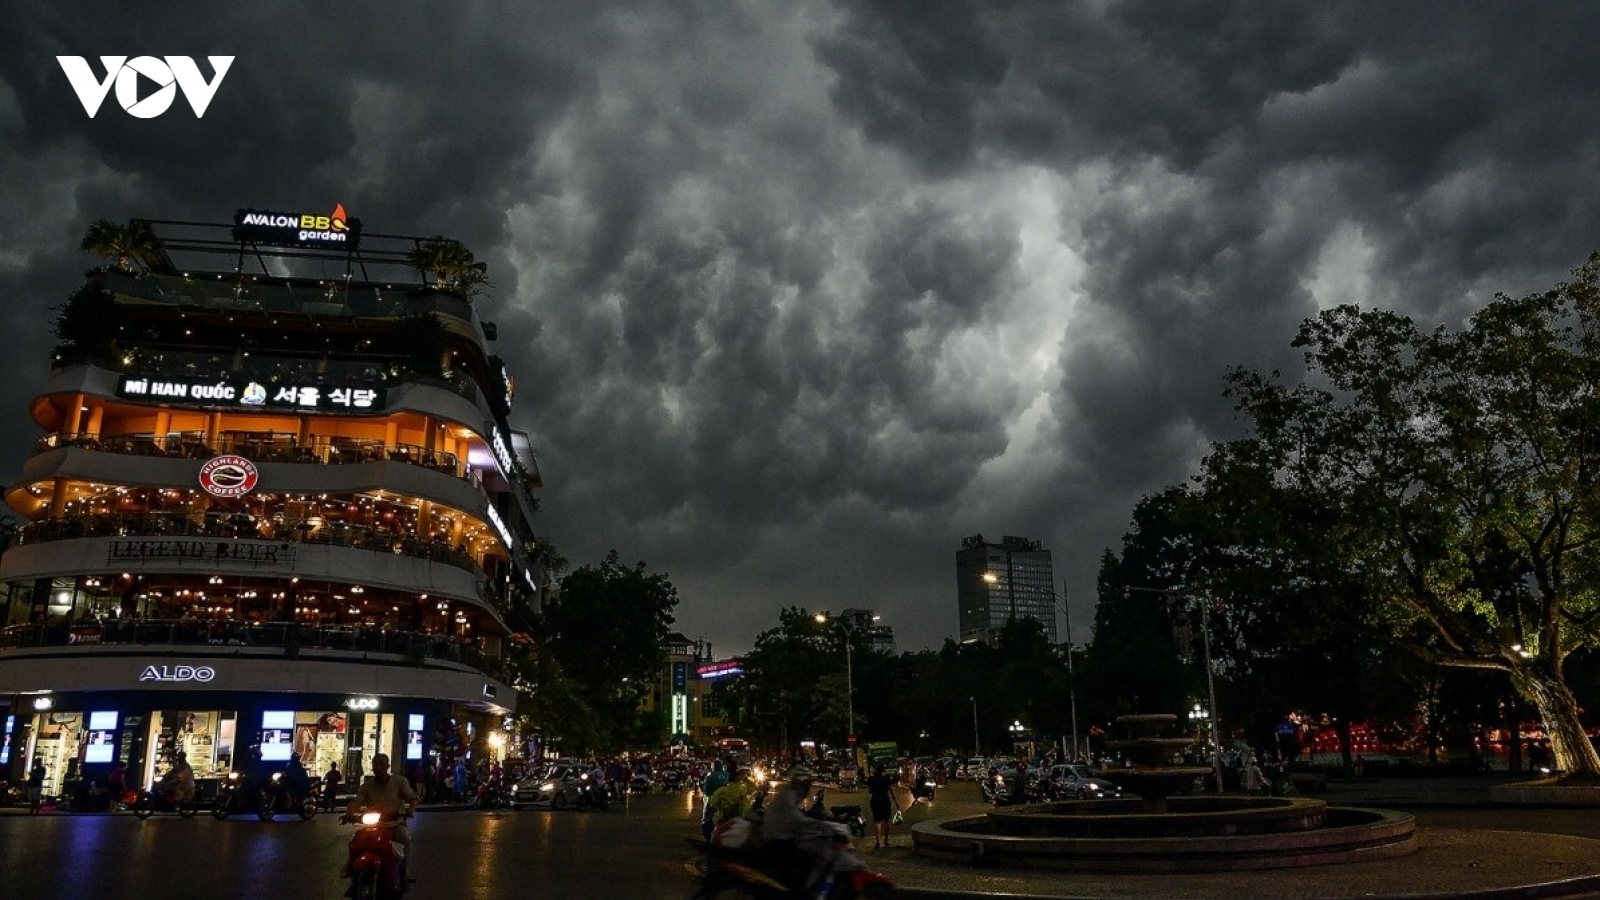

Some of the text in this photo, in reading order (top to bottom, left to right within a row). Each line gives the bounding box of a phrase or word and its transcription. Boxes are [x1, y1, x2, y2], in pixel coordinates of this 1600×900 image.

[243, 213, 298, 229] AVALON
[298, 229, 346, 242] garden
[125, 378, 147, 395] MÌ
[191, 381, 235, 399] QUỐC
[273, 386, 378, 408] 서울 식당
[203, 457, 255, 476] HIGHLANDS
[208, 484, 248, 495] COFFEE
[113, 541, 279, 562] LEGEND BEER
[138, 664, 216, 682] ALDO
